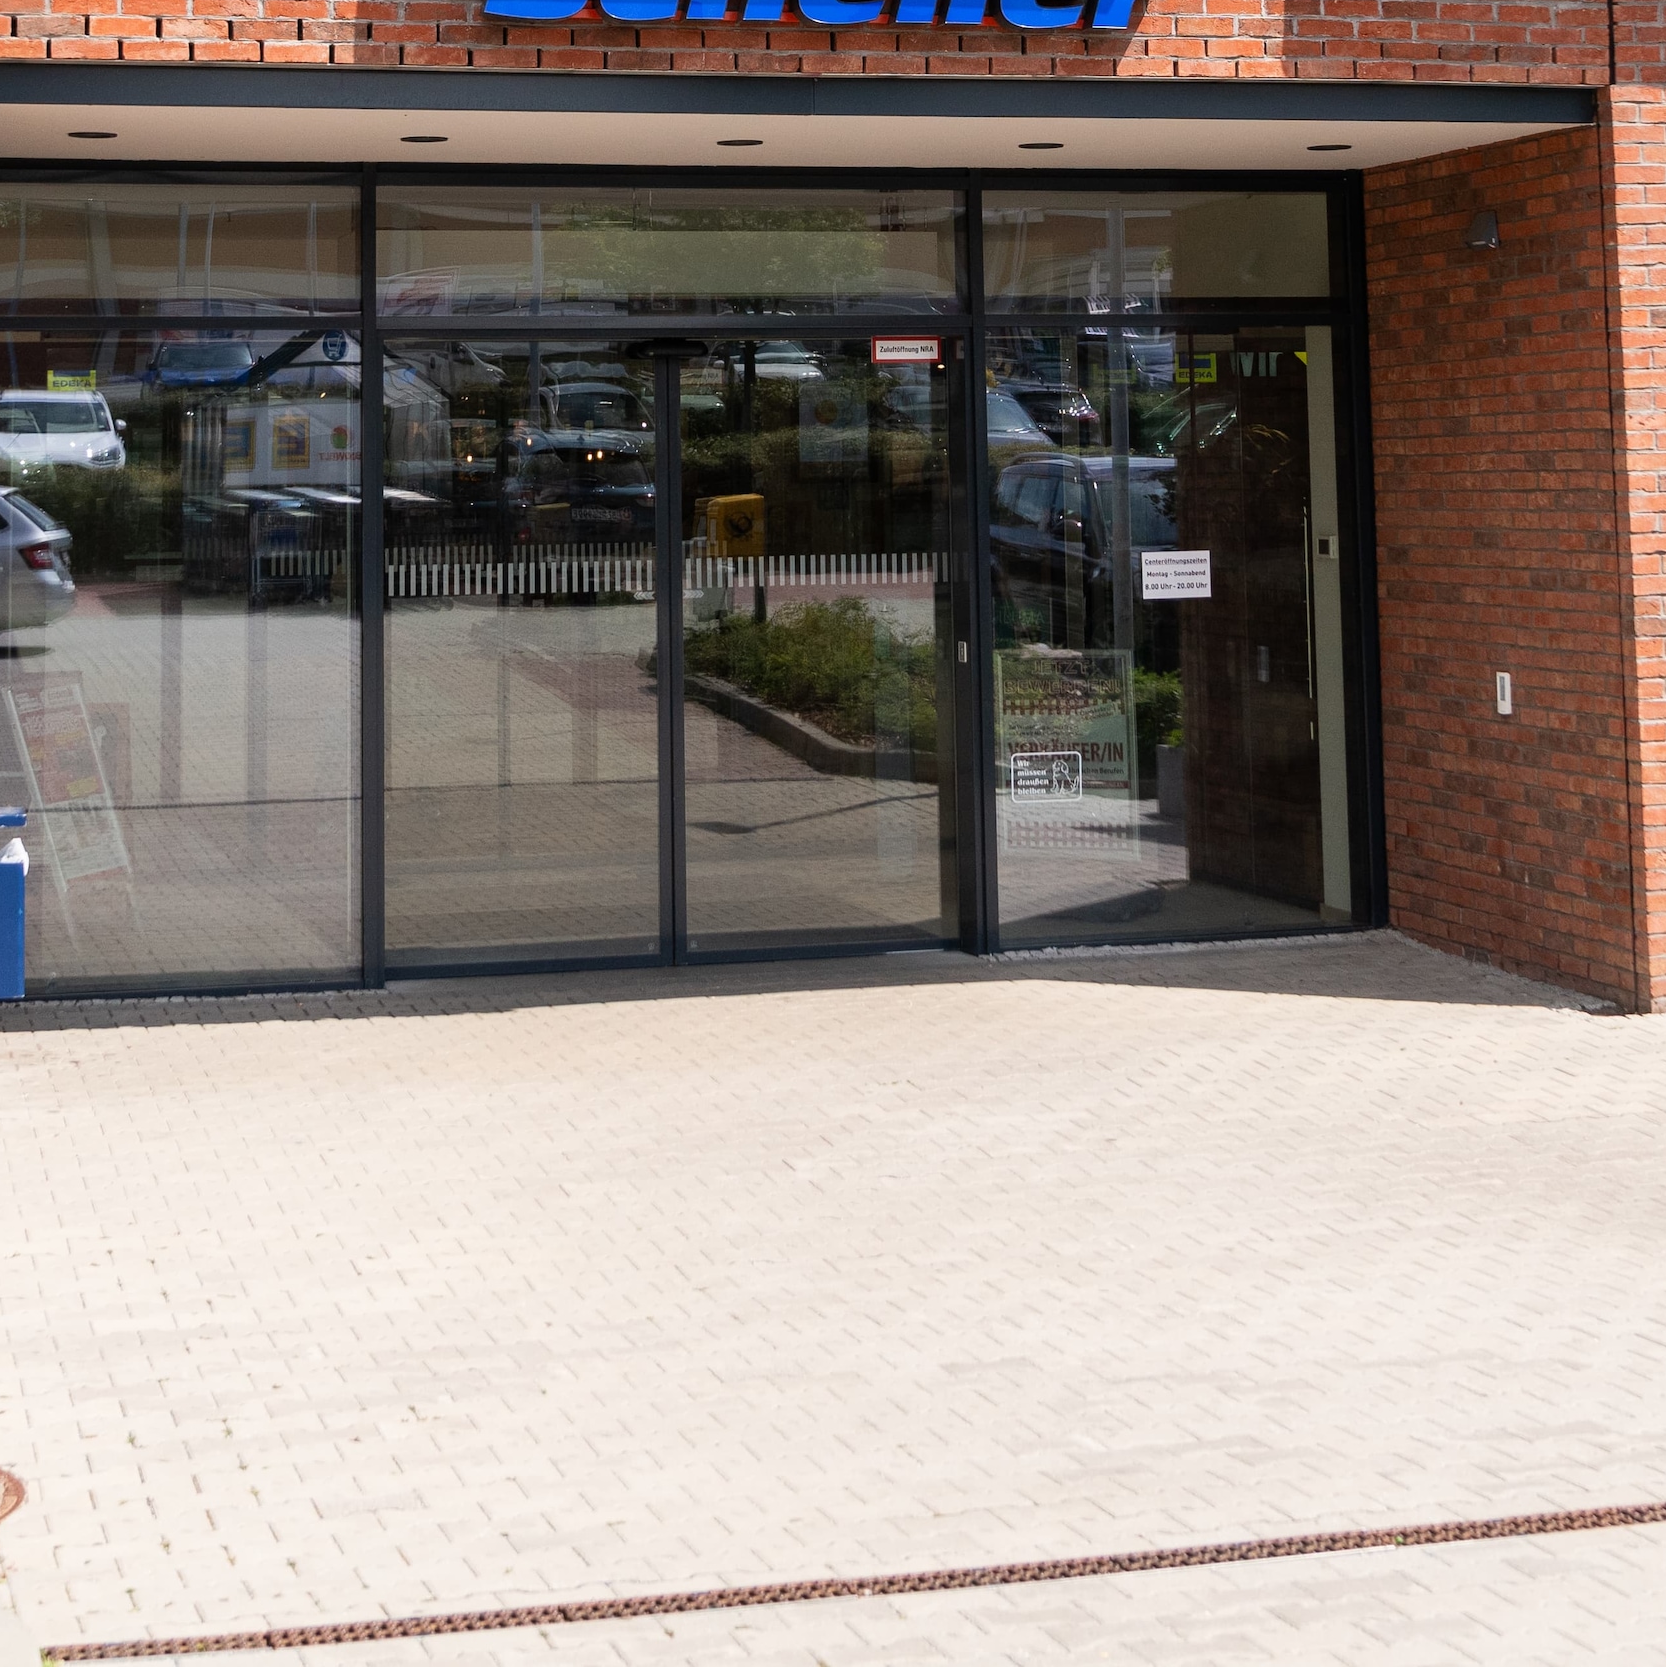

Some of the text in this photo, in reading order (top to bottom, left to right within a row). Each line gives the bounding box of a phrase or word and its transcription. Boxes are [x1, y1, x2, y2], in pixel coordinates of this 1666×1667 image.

[879, 345, 934, 354] Zuluftöffnung NRA
[53, 379, 92, 388] EDEKA
[1144, 557, 1208, 566] Centeröffnungszeiten
[1173, 569, 1206, 577] Sonnabend
[1144, 583, 1159, 591] 8.00
[1177, 582, 1195, 590] 20.00
[1195, 581, 1208, 589] Uhr
[1033, 659, 1091, 675] JETZT
[1017, 759, 1029, 767] Wir
[1017, 769, 1047, 777] müssen
[1017, 778, 1050, 786] draußen
[1017, 787, 1046, 795] bleiben
